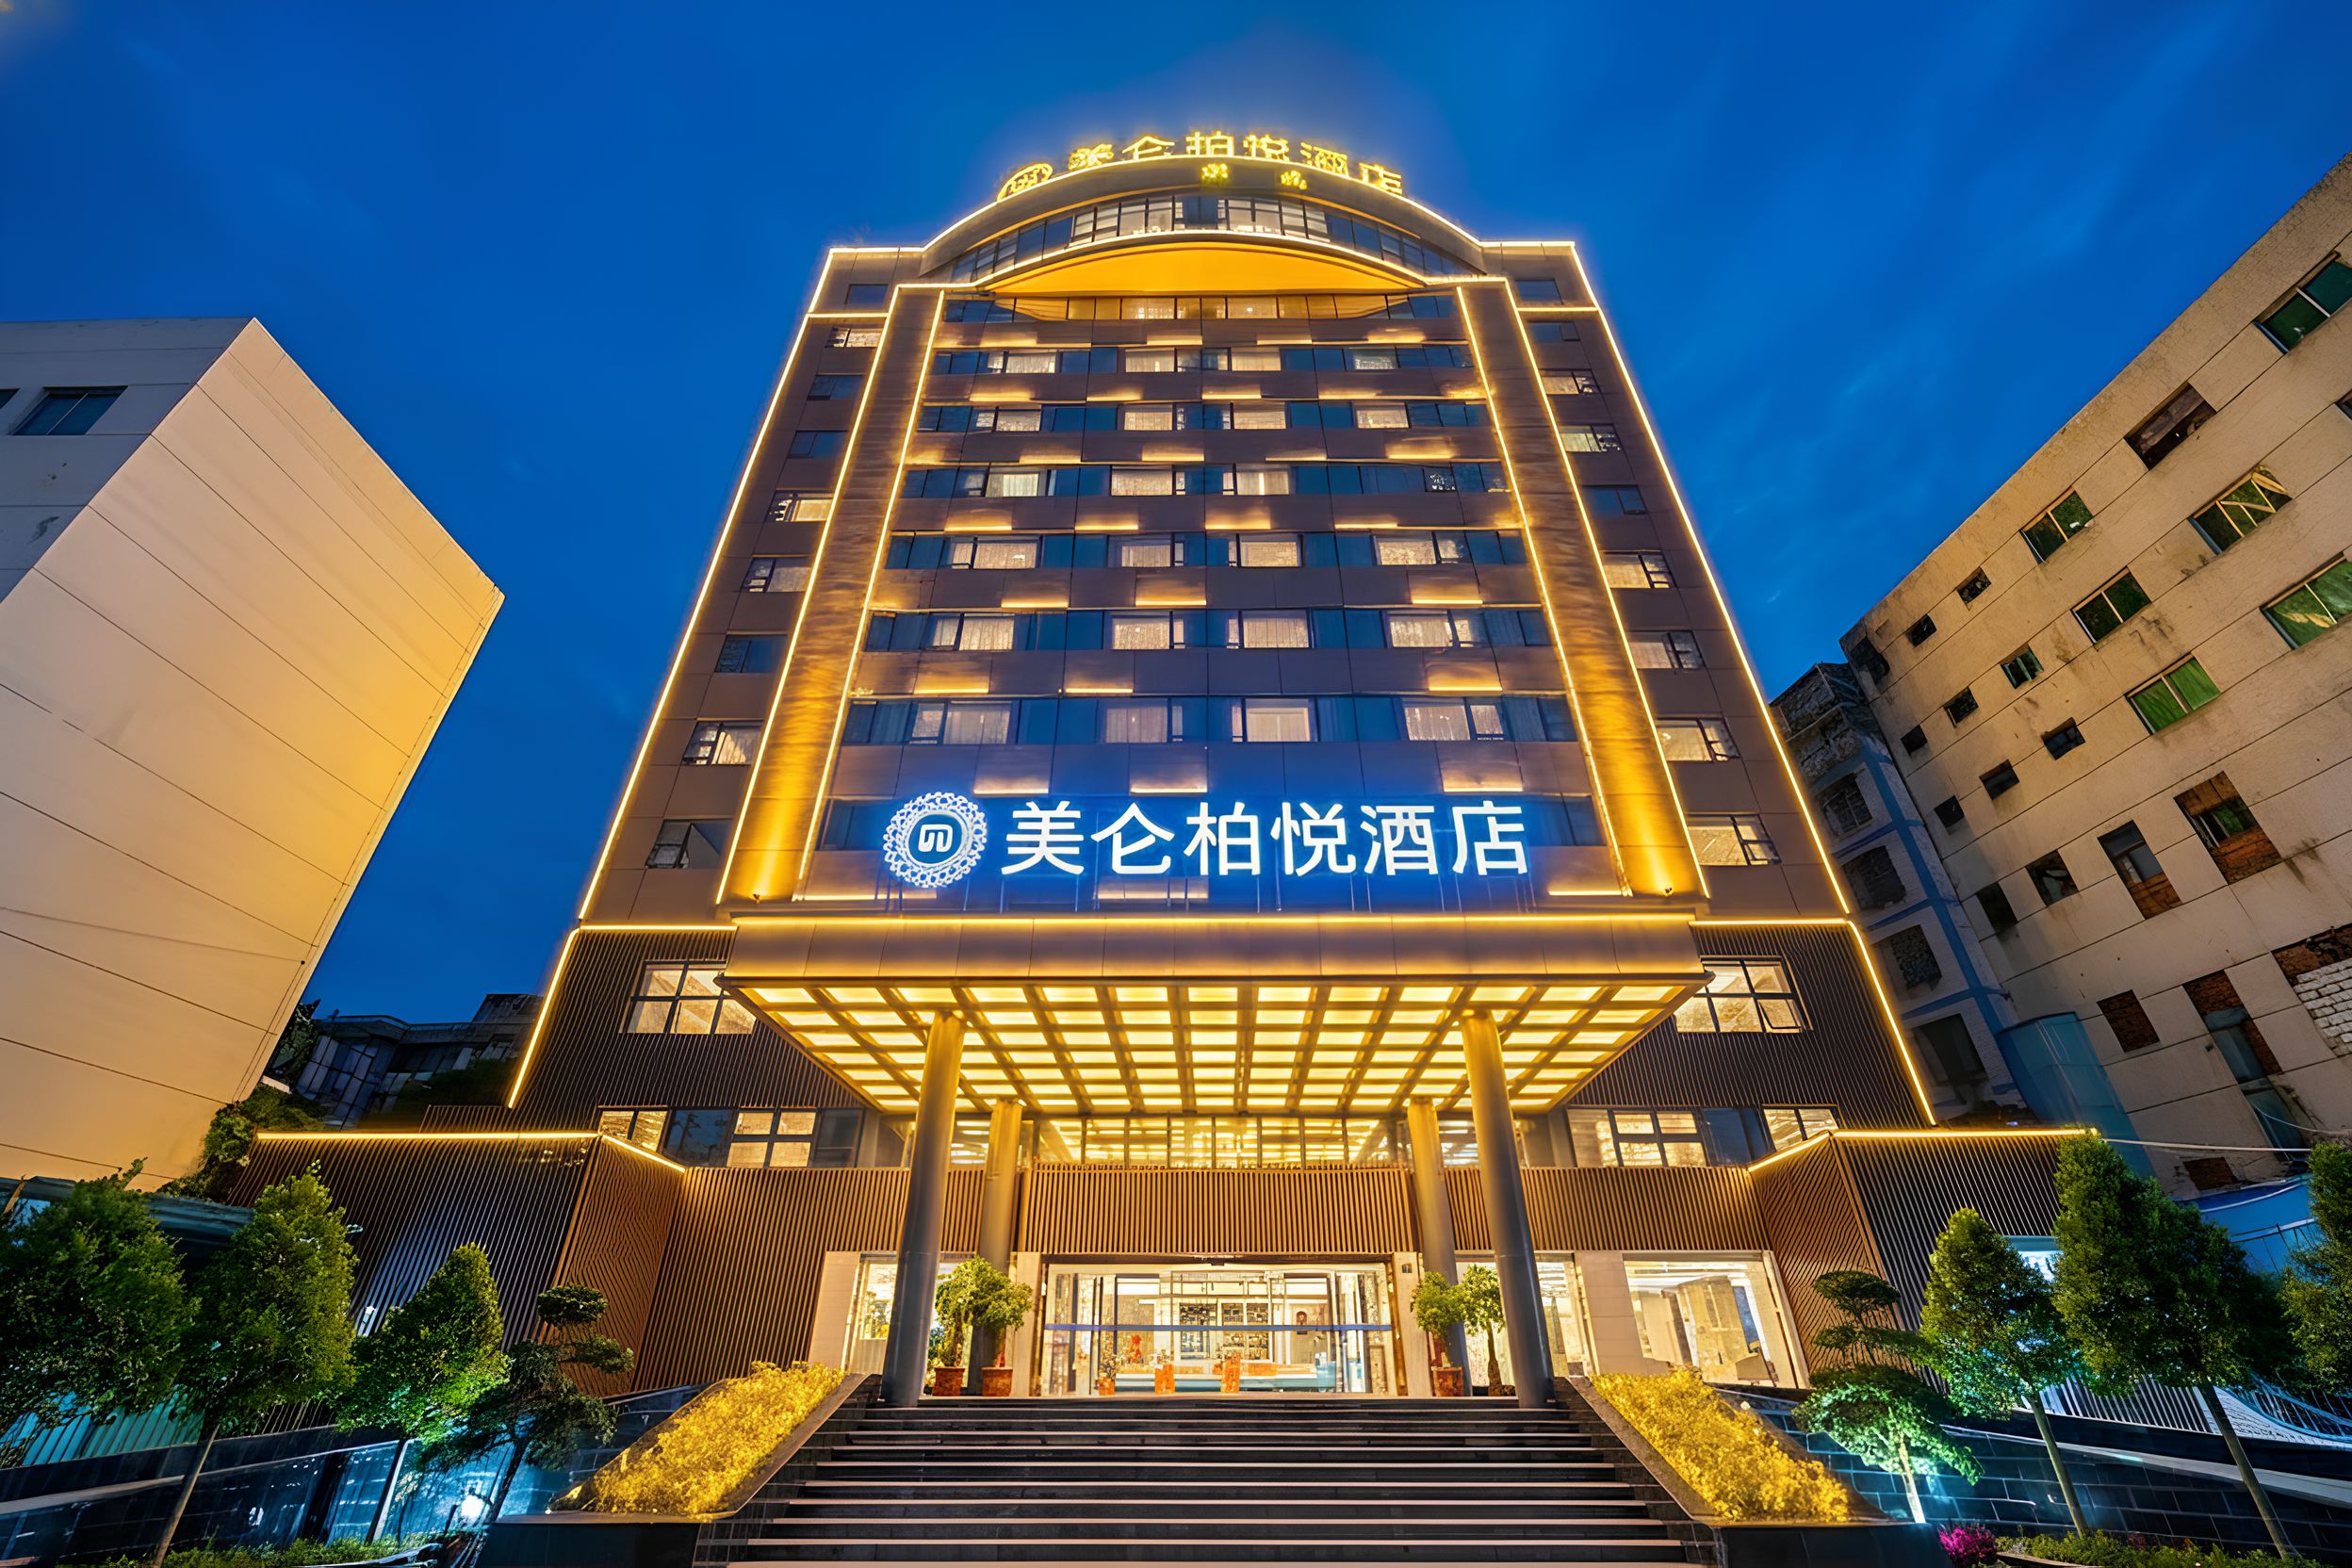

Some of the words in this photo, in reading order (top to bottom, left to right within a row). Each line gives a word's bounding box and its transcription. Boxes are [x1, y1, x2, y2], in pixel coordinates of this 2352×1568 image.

[1001, 800, 1528, 876] 美仑柏悦酒店
